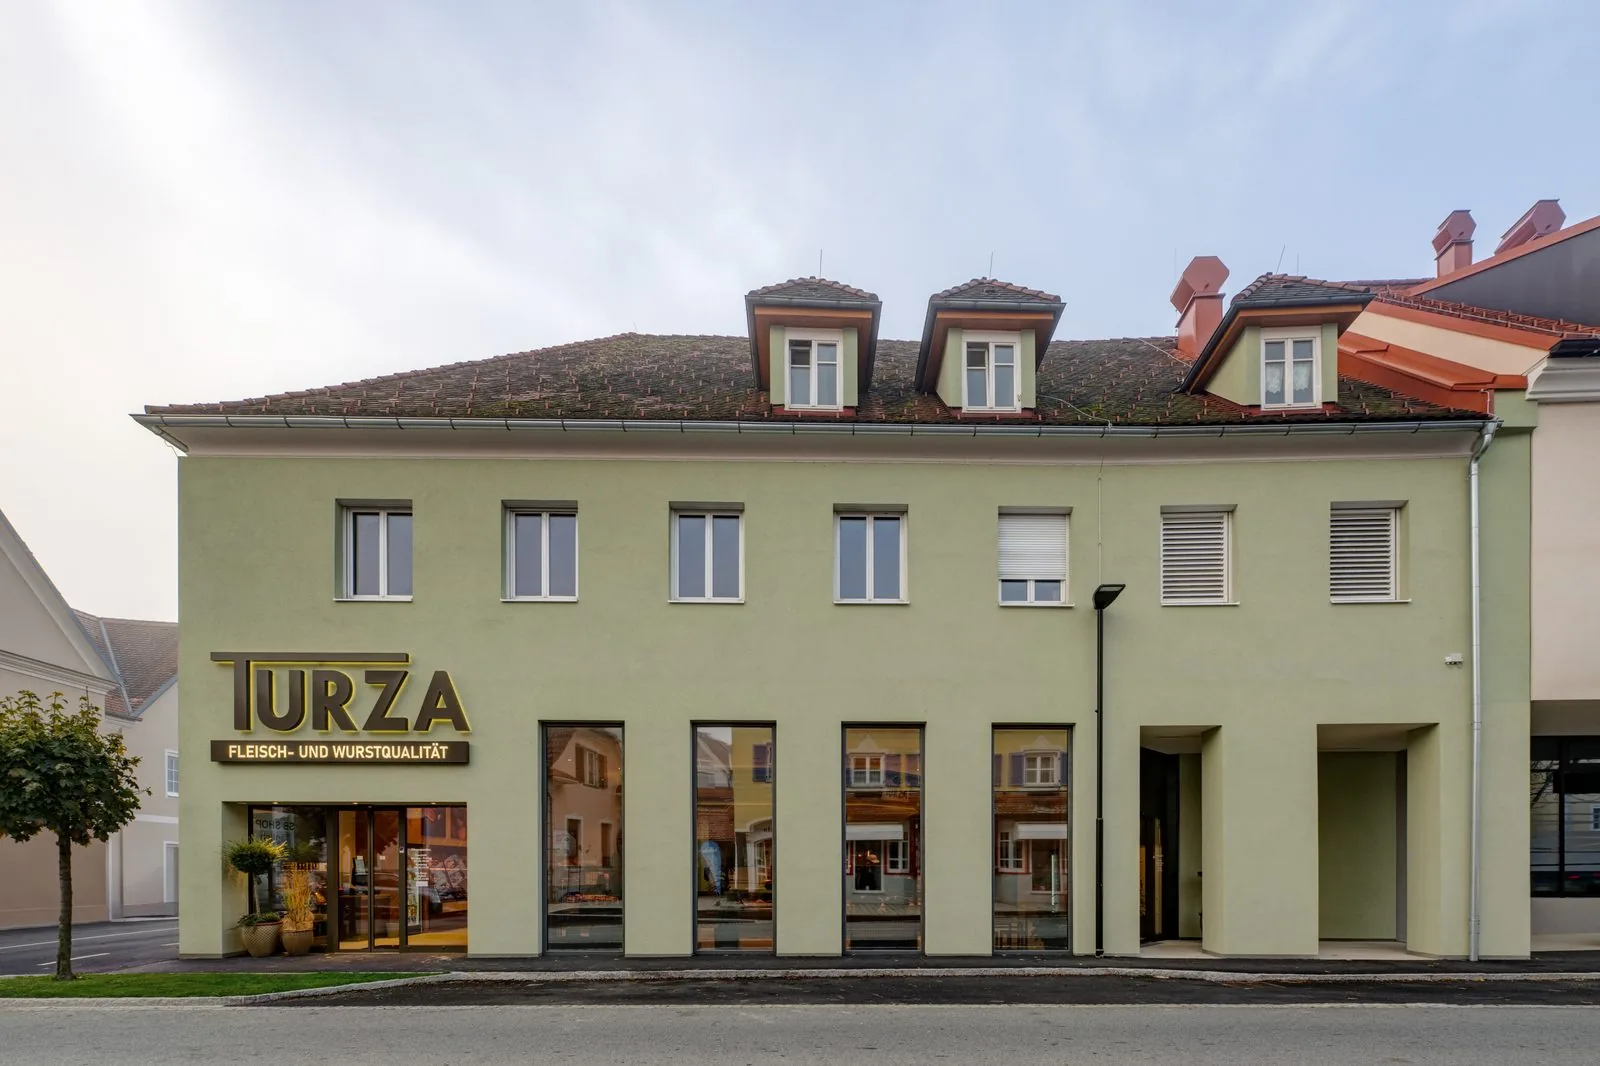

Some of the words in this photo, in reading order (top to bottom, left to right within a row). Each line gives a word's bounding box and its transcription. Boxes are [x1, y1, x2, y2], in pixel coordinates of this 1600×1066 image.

[210, 652, 471, 732] TURZA
[228, 744, 294, 759] FLEISCH-
[299, 745, 329, 759] UND
[332, 742, 449, 760] WURSTQUALITÄT
